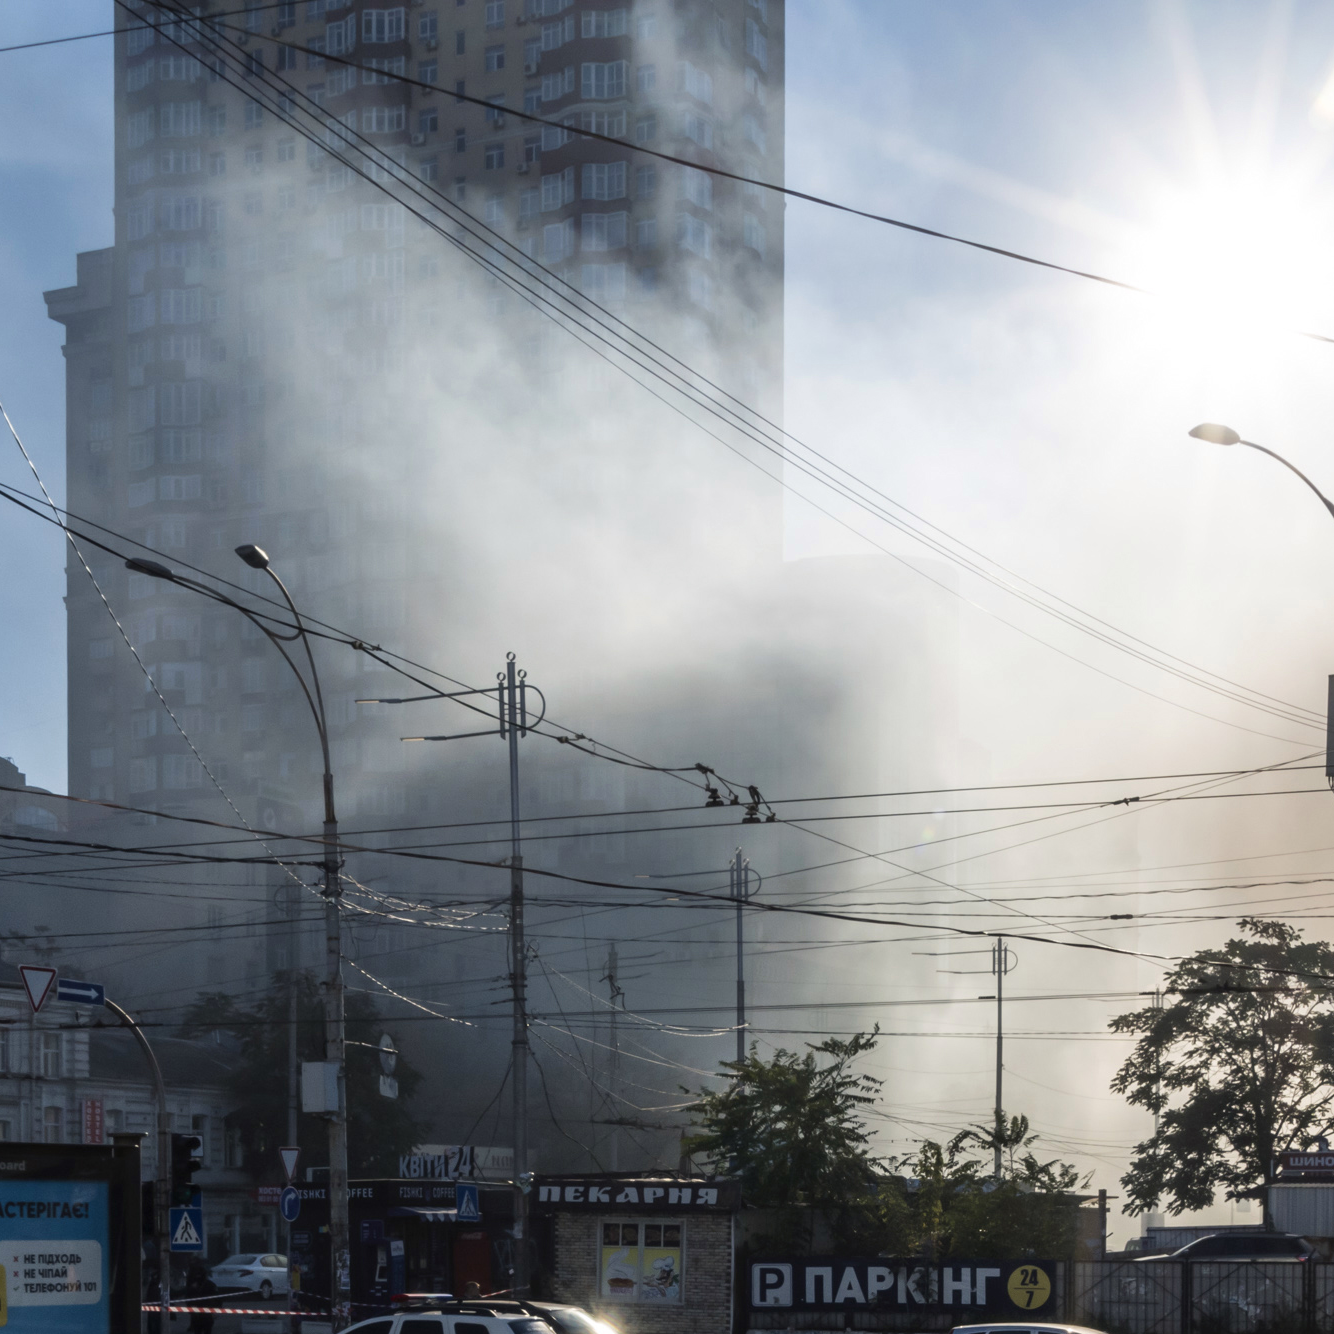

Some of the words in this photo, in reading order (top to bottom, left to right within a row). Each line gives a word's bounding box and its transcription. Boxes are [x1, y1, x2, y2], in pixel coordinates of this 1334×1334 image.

[399, 1154, 447, 1178] КВІТИ
[446, 1146, 472, 1179] 24
[298, 1188, 326, 1199] ISHKI
[346, 1187, 374, 1199] OFFEE
[399, 1187, 423, 1199] FISHKI
[432, 1187, 455, 1199] COFFEE
[538, 1185, 718, 1205] ПЕКАРНЯ
[24, 1254, 35, 1264] НЕ
[38, 1254, 82, 1265] ПІДХОДЬ
[24, 1269, 36, 1279] НЕ
[38, 1266, 67, 1278] ЧІПАЙ
[1020, 1269, 1039, 1286] 24
[24, 1280, 82, 1293] ТЕЛЕФОНУЙ
[84, 1282, 97, 1292] 101
[805, 1266, 1001, 1306] ПАРКІНГ
[1025, 1291, 1035, 1308] 7
